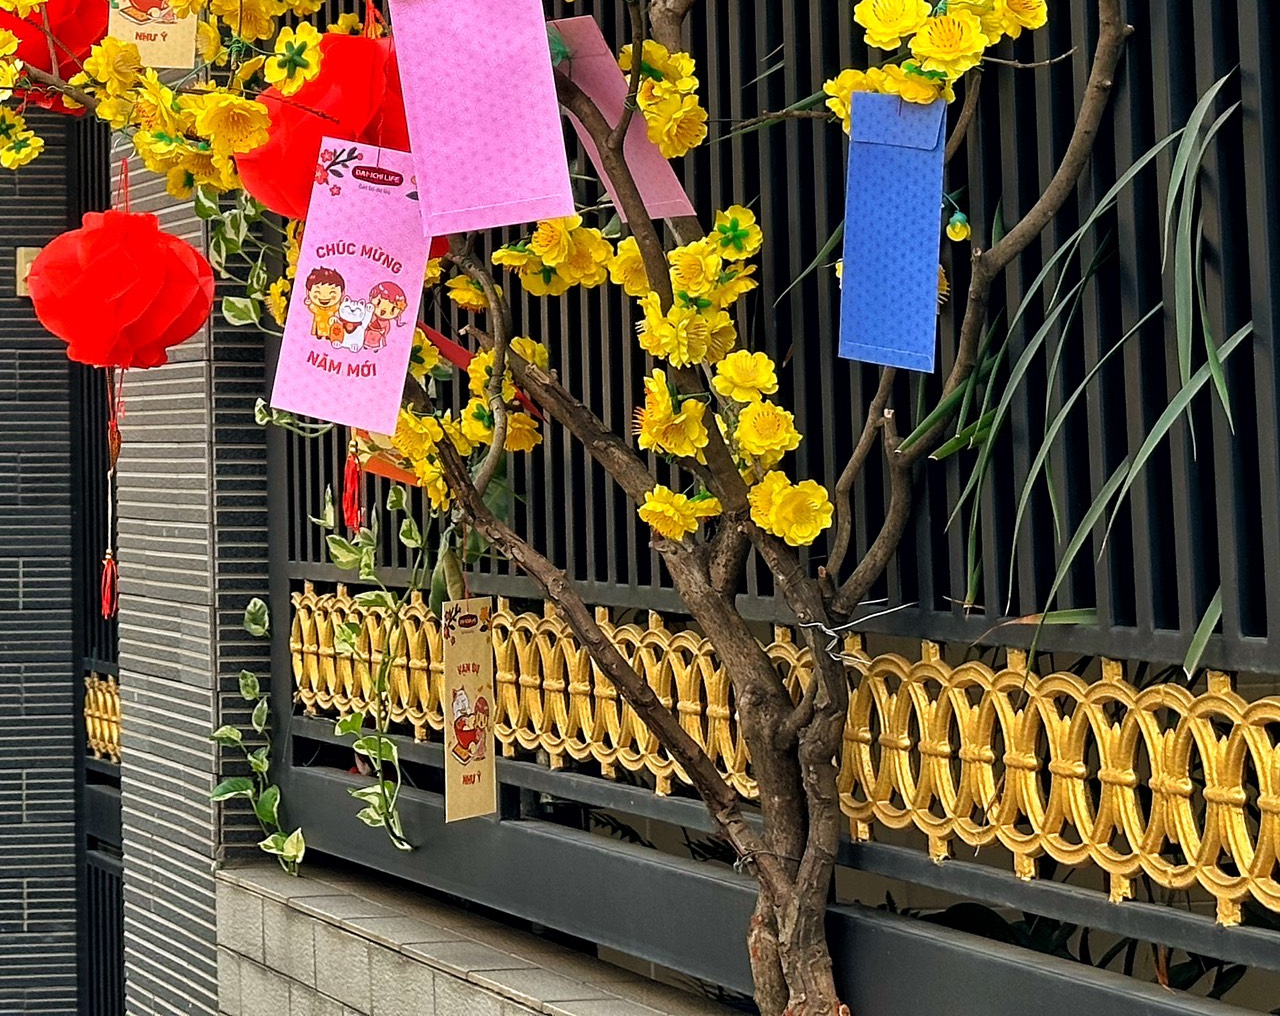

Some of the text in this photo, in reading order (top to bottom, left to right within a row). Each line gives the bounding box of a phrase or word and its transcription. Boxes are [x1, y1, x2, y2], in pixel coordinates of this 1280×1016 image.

[135, 30, 168, 42] NHƯ Ý
[316, 240, 403, 274] CHÚC MỪNG
[307, 350, 377, 377] NĂM MỚI
